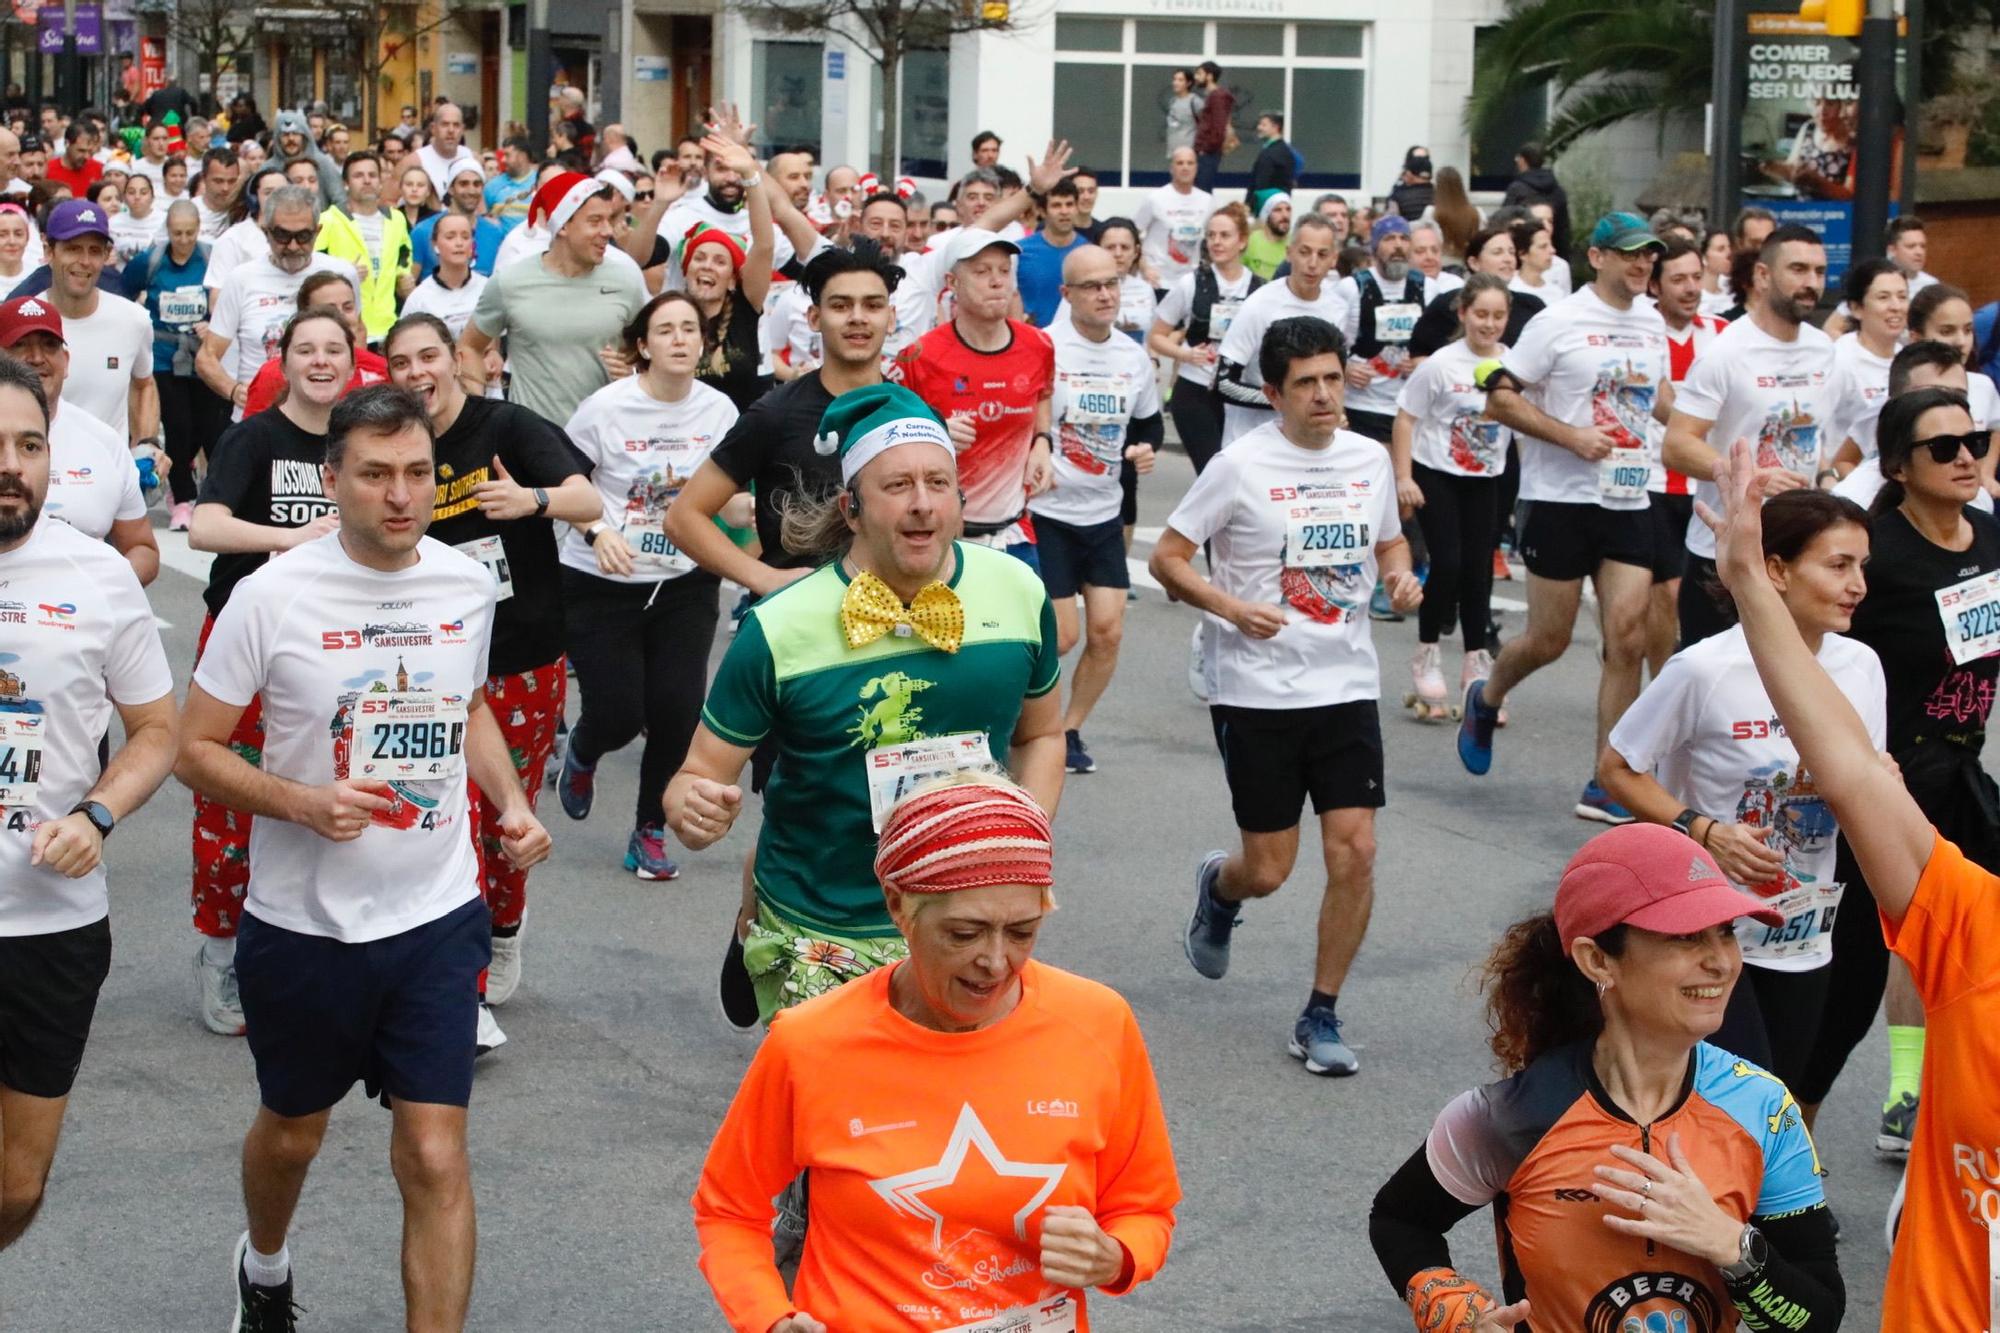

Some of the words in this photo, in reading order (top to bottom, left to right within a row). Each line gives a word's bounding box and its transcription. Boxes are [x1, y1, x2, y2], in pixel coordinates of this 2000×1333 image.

[1750, 44, 1830, 61] COMER
[1749, 64, 1783, 79] NO
[1786, 64, 1852, 81] PUEDE
[1749, 82, 1787, 98] SER
[1792, 82, 1824, 98] UN
[1079, 393, 1117, 414] 4660
[272, 459, 323, 495] MISSOURI
[1270, 487, 1297, 501] 53
[1302, 523, 1355, 551] 2326
[1941, 591, 1961, 607] 53
[322, 630, 362, 650] 53
[374, 634, 433, 648] SANSILVESTRE
[362, 700, 389, 714] 53
[371, 721, 447, 759] 2396
[1732, 720, 1769, 740] 53
[1761, 908, 1817, 947] 1457
[1609, 1275, 1696, 1309] BEER
